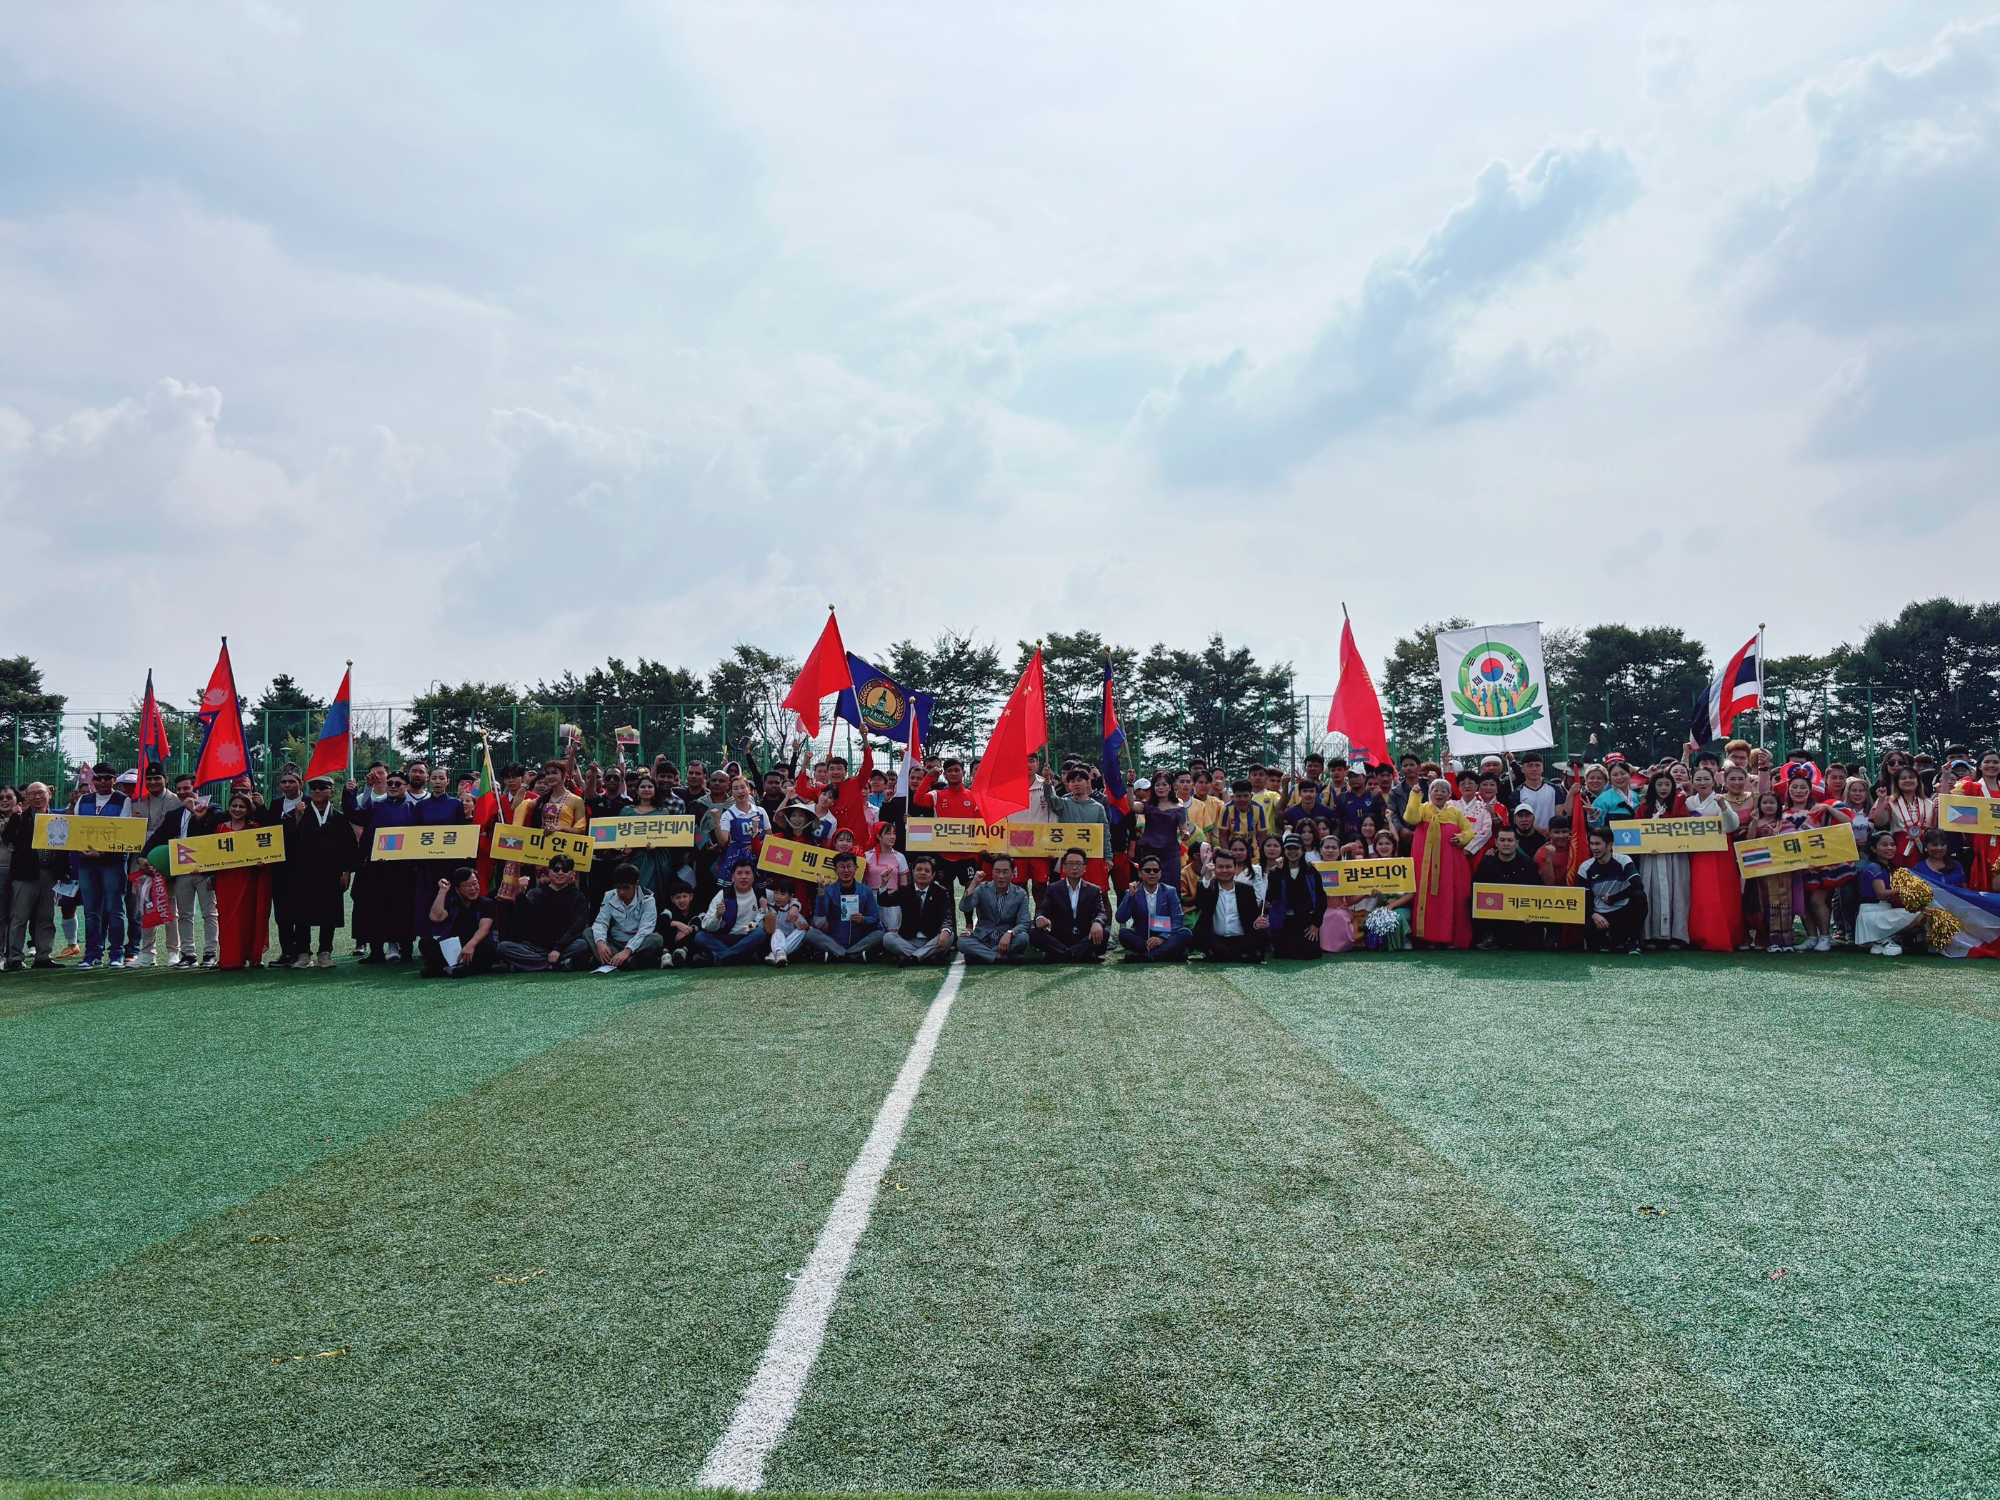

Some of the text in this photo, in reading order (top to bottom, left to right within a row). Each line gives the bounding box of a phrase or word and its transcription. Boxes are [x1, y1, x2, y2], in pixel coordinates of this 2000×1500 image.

[617, 820, 693, 836] 방글라데시
[934, 823, 1006, 839] 인도네시아
[1641, 820, 1722, 837] 고려인협회
[1343, 864, 1407, 882] 캄보디아
[1508, 897, 1578, 911] 키르기스스탄
